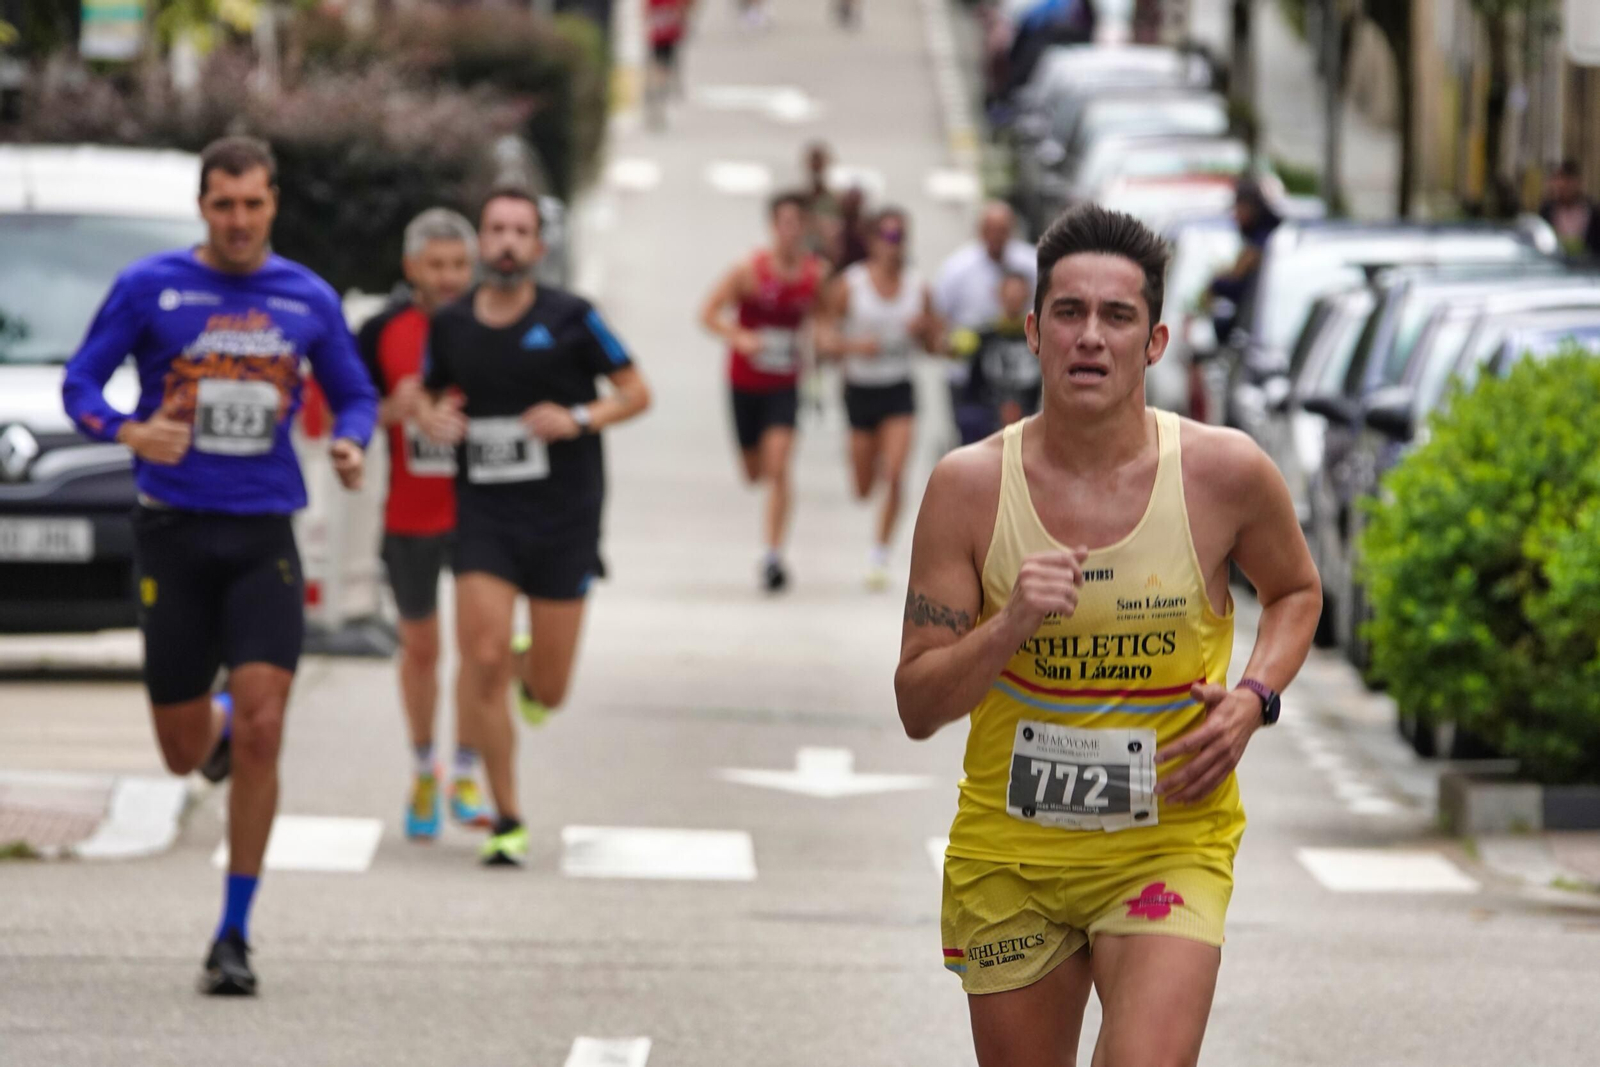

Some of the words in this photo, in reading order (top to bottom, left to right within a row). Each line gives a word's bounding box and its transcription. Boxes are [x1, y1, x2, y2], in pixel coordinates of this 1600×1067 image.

[1116, 597, 1142, 612] San
[1145, 594, 1187, 610] Lázaro
[1016, 630, 1176, 659] ATHLETICS
[1034, 656, 1072, 680] San
[1079, 658, 1153, 681] Lázaro
[1030, 759, 1109, 808] 772
[968, 933, 1045, 961] ATHLETICS
[979, 959, 995, 969] San
[996, 952, 1026, 966] Lázaro
